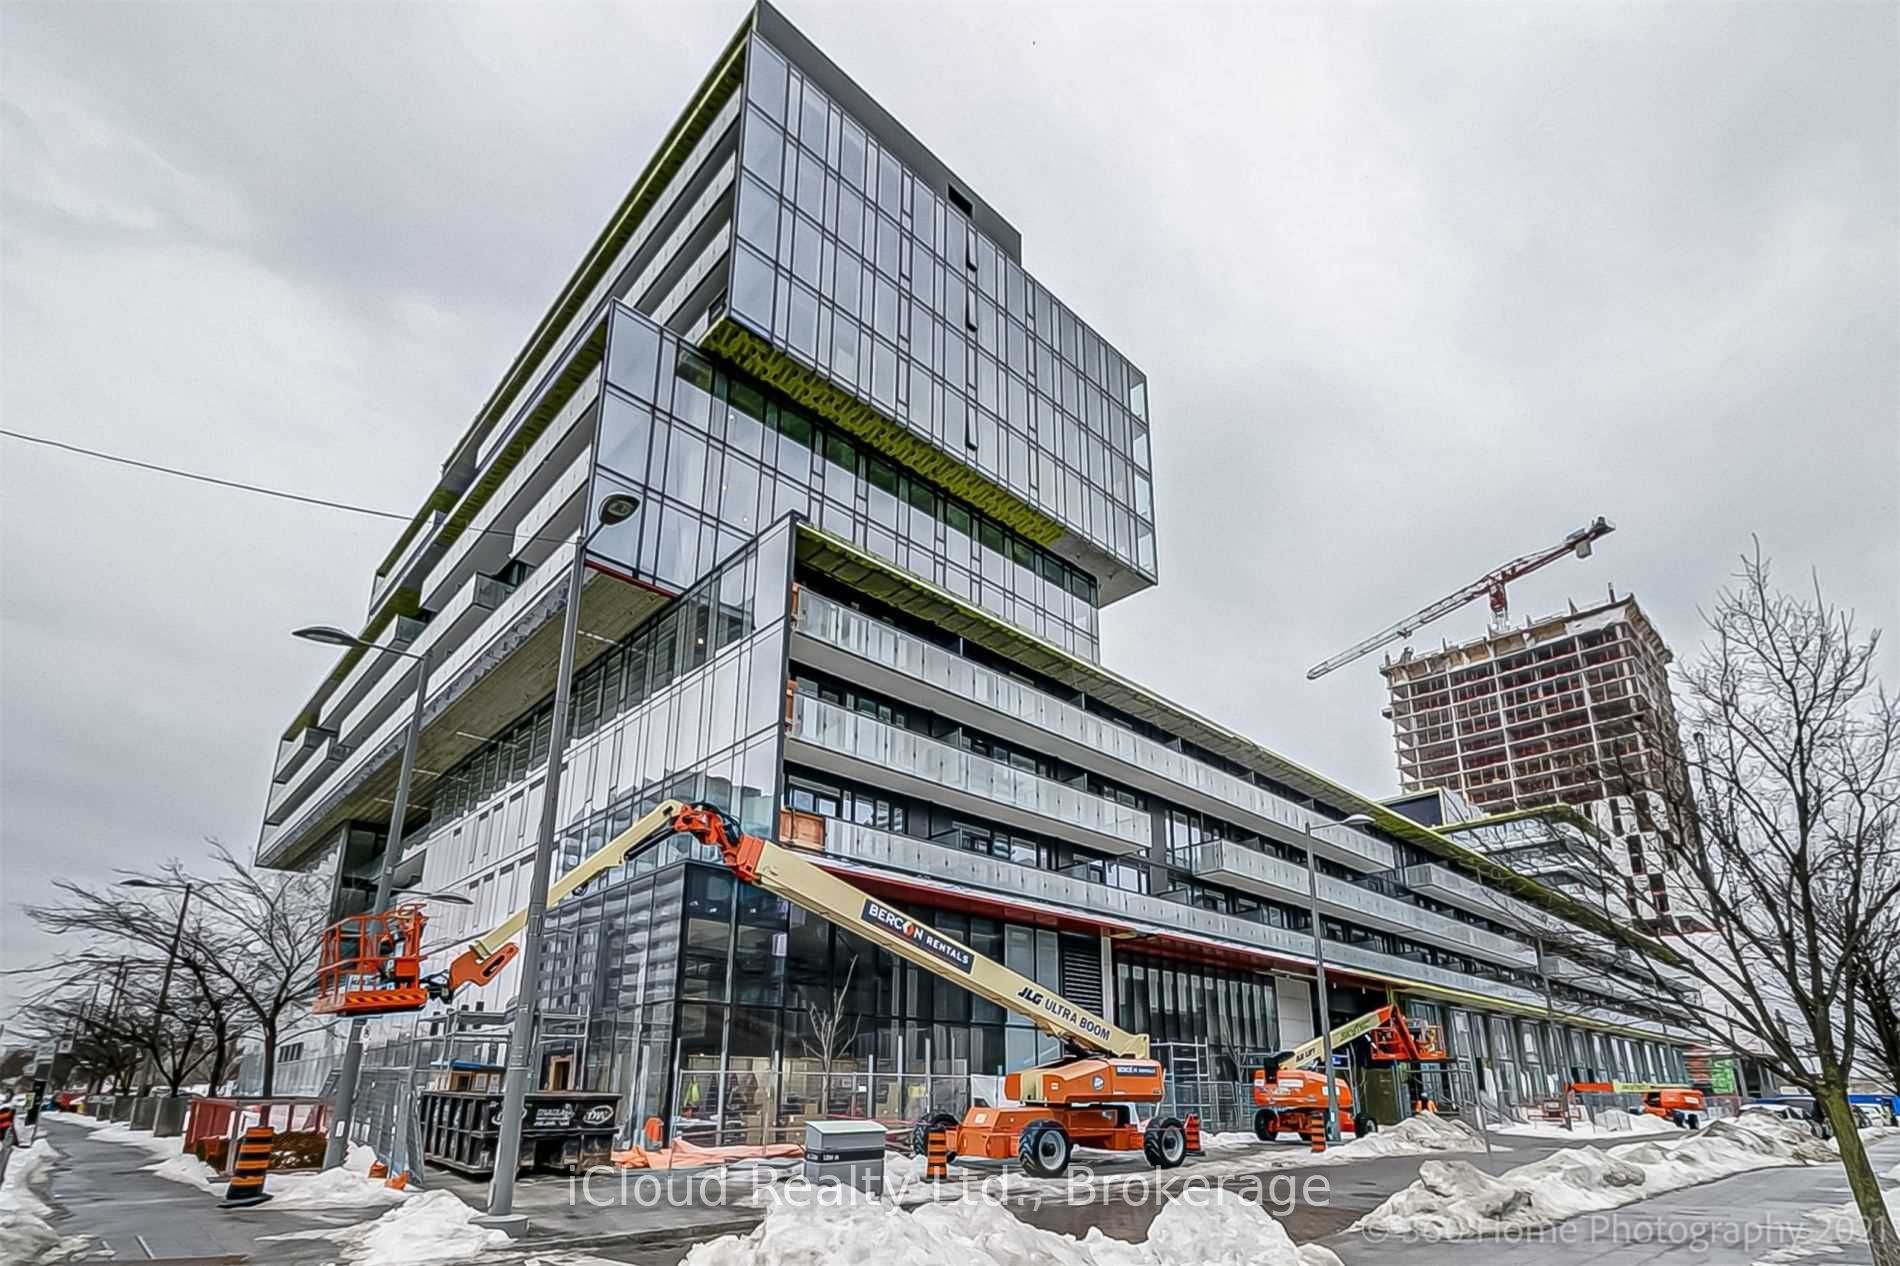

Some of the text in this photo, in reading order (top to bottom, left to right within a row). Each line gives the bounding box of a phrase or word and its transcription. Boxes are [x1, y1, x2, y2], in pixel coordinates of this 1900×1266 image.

[868, 903, 969, 964] BERCON RENTALS
[1017, 987, 1111, 1041] JLG ULTRA BOOM
